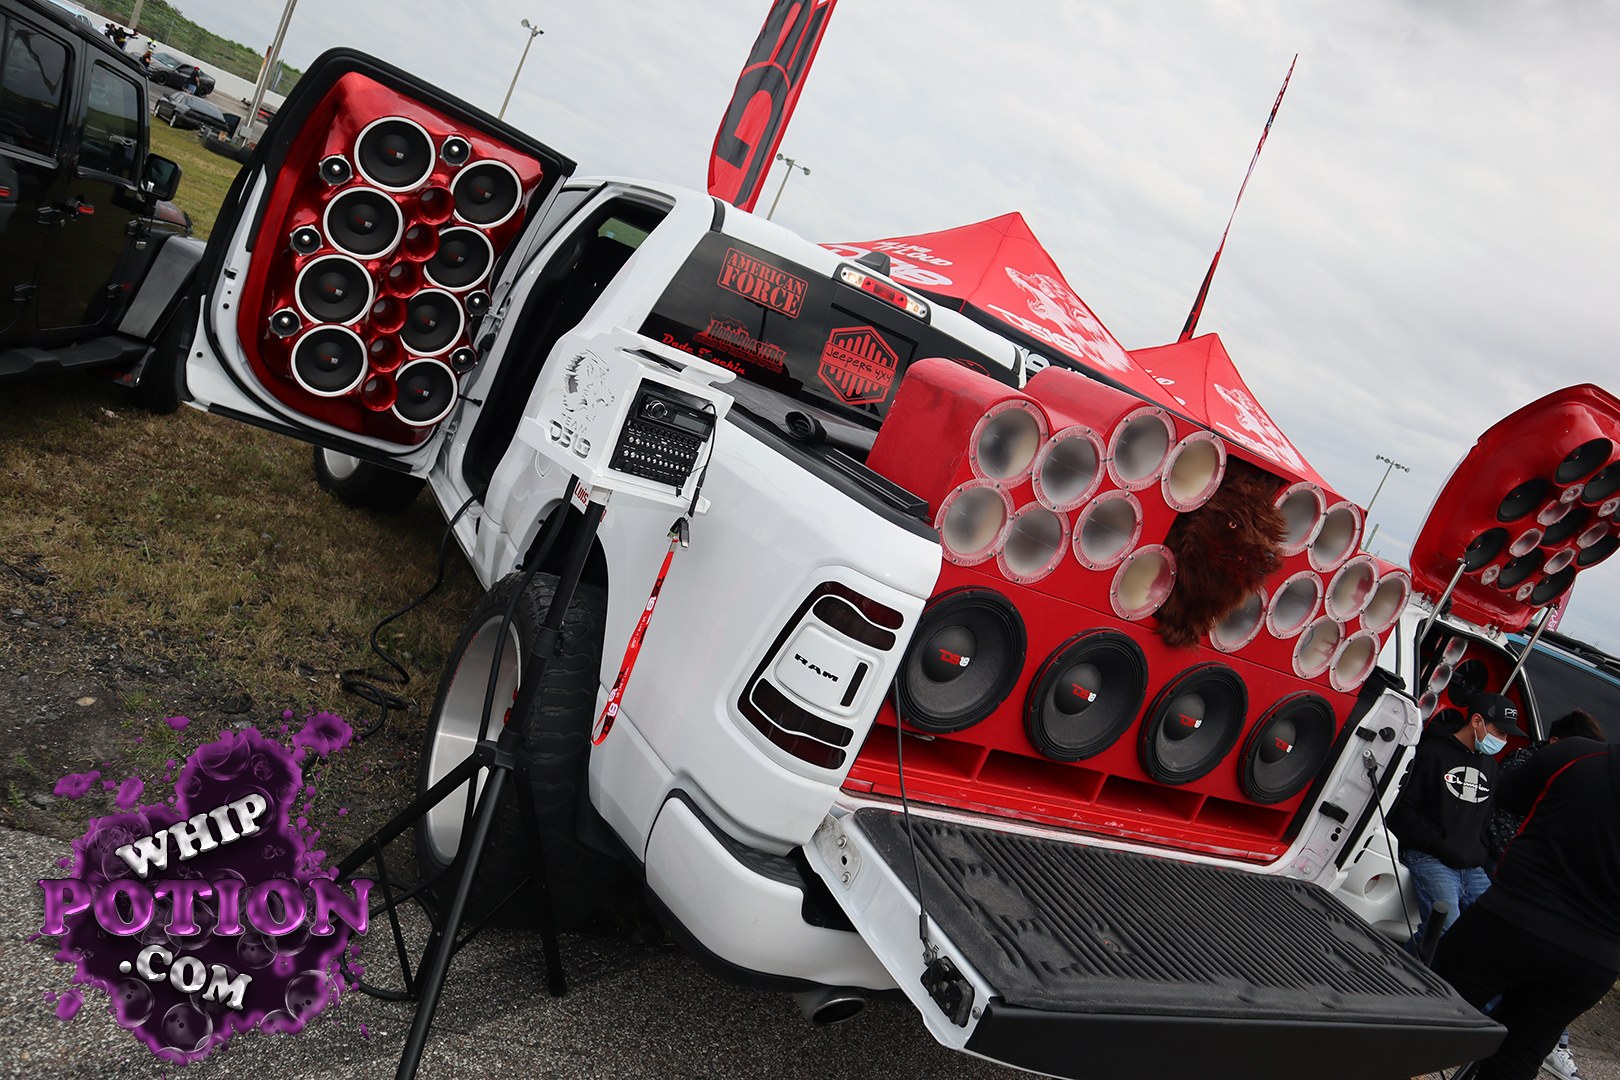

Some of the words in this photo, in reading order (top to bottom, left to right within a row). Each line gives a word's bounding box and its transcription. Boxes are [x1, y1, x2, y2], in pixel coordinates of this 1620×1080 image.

[727, 253, 805, 296] AMERICAN
[721, 264, 801, 315] FORCE
[662, 333, 693, 355] Dade
[794, 653, 839, 682] RAM
[939, 648, 971, 668] DS18
[1071, 683, 1098, 703] DS18
